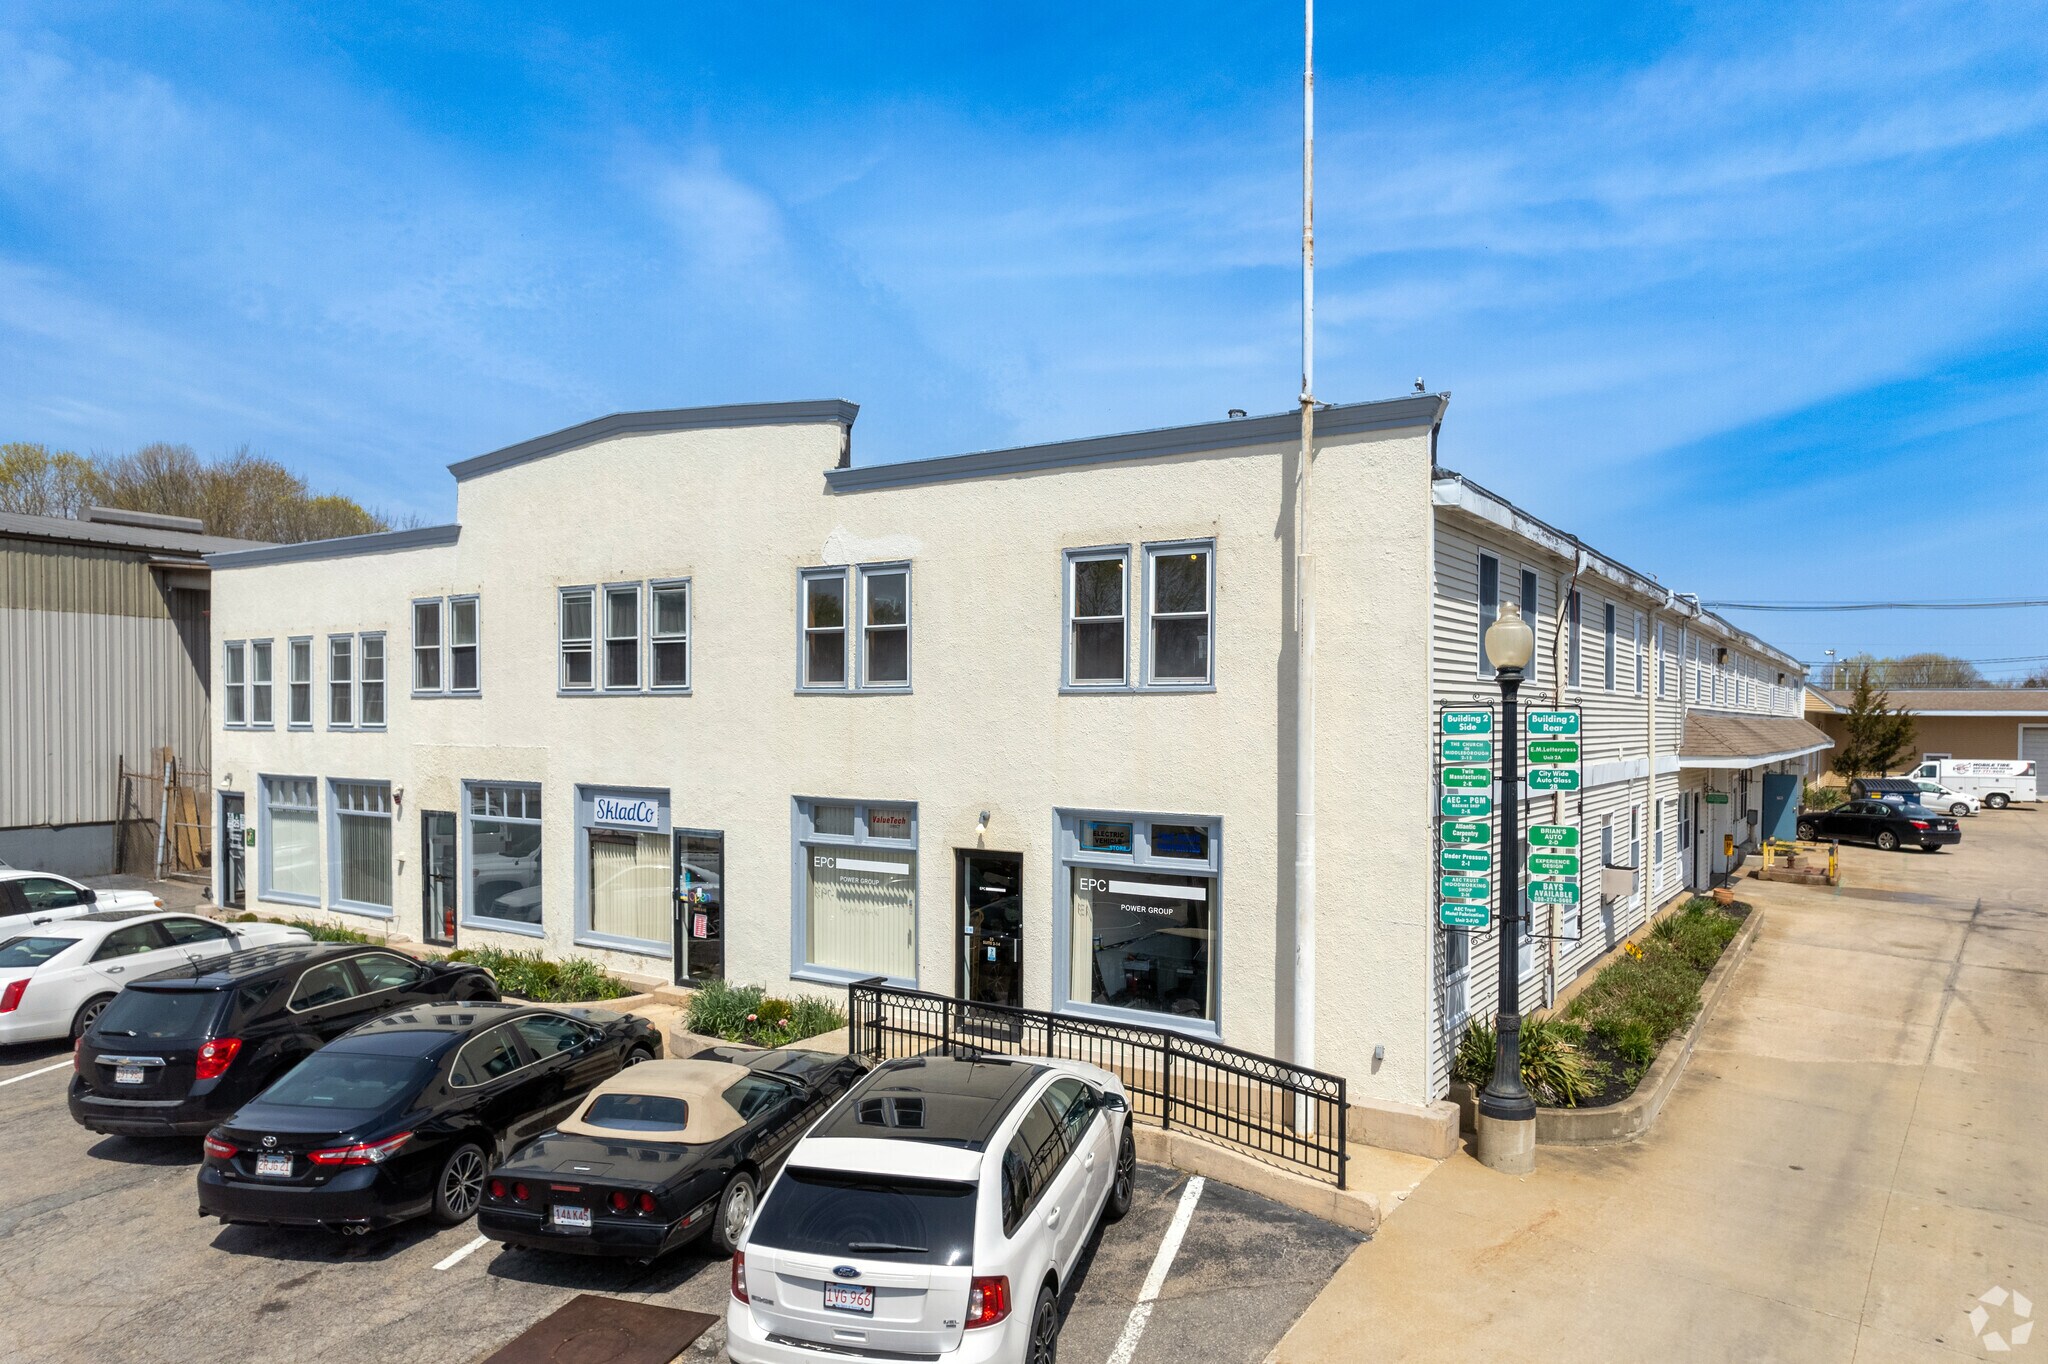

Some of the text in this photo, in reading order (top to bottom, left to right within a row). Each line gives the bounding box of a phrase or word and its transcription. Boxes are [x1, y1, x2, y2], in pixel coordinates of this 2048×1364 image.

[1447, 715, 1481, 724] Building
[1532, 715, 1567, 724] Building
[597, 799, 655, 823] SkladCo
[872, 816, 906, 824] ValueTech
[813, 855, 835, 869] EPC
[1080, 878, 1107, 892] EPC
[1534, 890, 1573, 898] AVAILABLE
[1121, 904, 1173, 915] POWER GROUP
[258, 1160, 289, 1171] 2RJG 21
[838, 1268, 854, 1277] Ford
[826, 1288, 847, 1304] 1VG
[850, 1291, 871, 1307] 966
